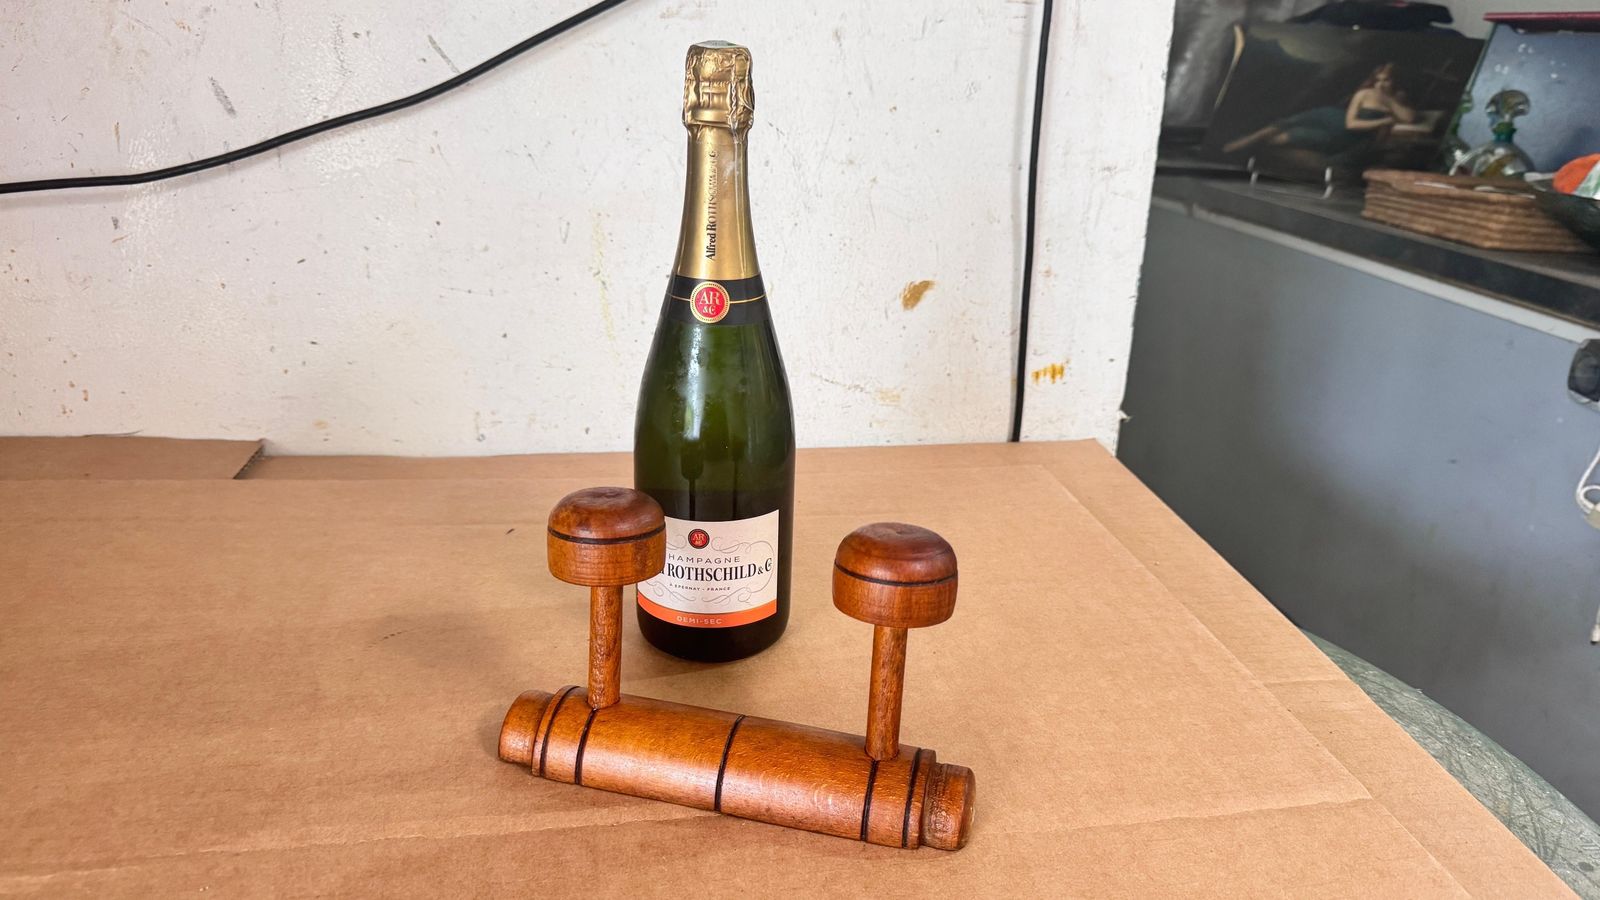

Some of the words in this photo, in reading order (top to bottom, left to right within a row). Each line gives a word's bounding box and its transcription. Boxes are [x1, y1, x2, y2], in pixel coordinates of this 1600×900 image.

[705, 233, 717, 261] Alfred
[699, 291, 721, 305] AR
[668, 553, 741, 564] HAMPAGNE
[676, 615, 723, 625] DEMI-SEC
